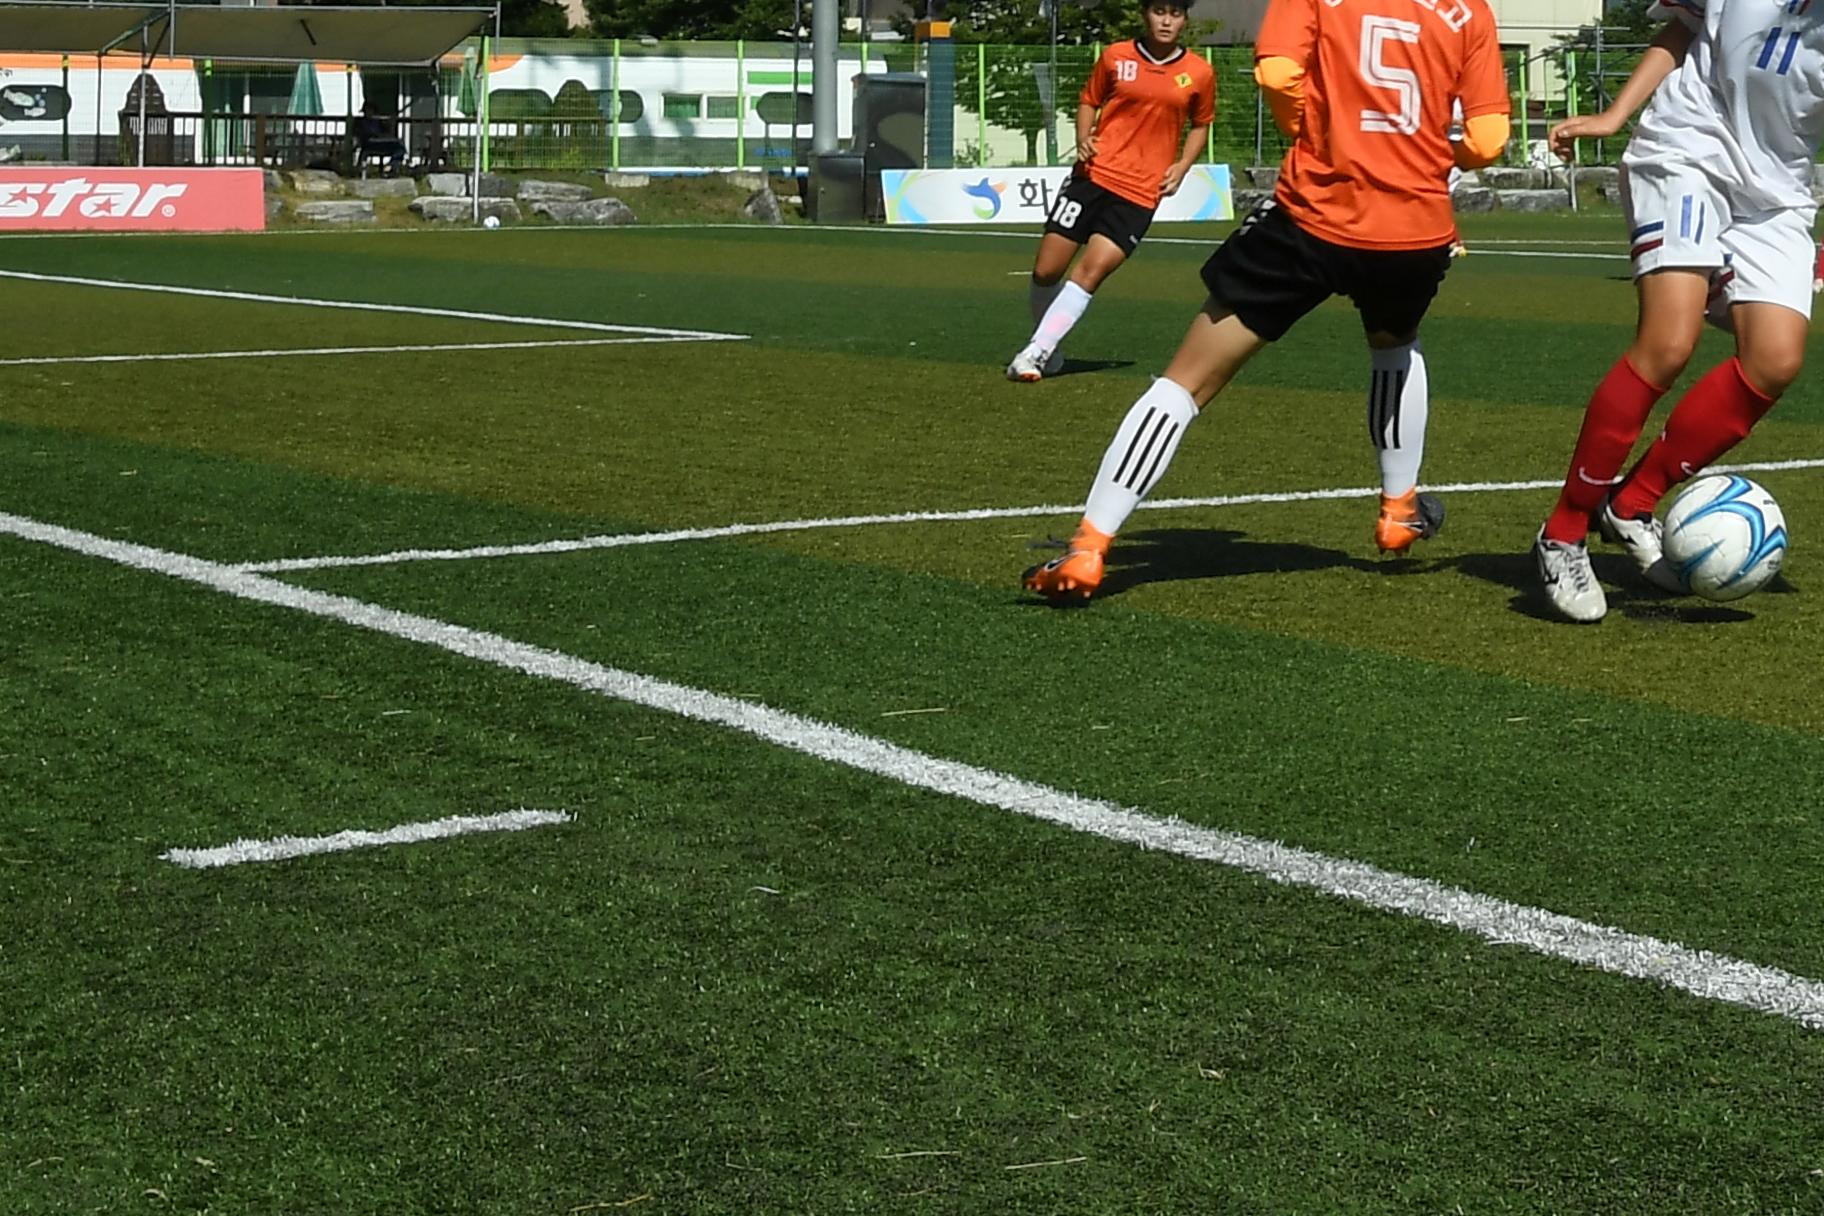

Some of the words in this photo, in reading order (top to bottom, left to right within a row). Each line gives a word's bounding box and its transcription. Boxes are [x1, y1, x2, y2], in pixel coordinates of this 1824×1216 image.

[1115, 60, 1138, 81] 18
[1359, 14, 1422, 136] 5
[1755, 25, 1801, 76] 11
[1052, 196, 1082, 229] 18
[1680, 195, 1706, 246] 11
